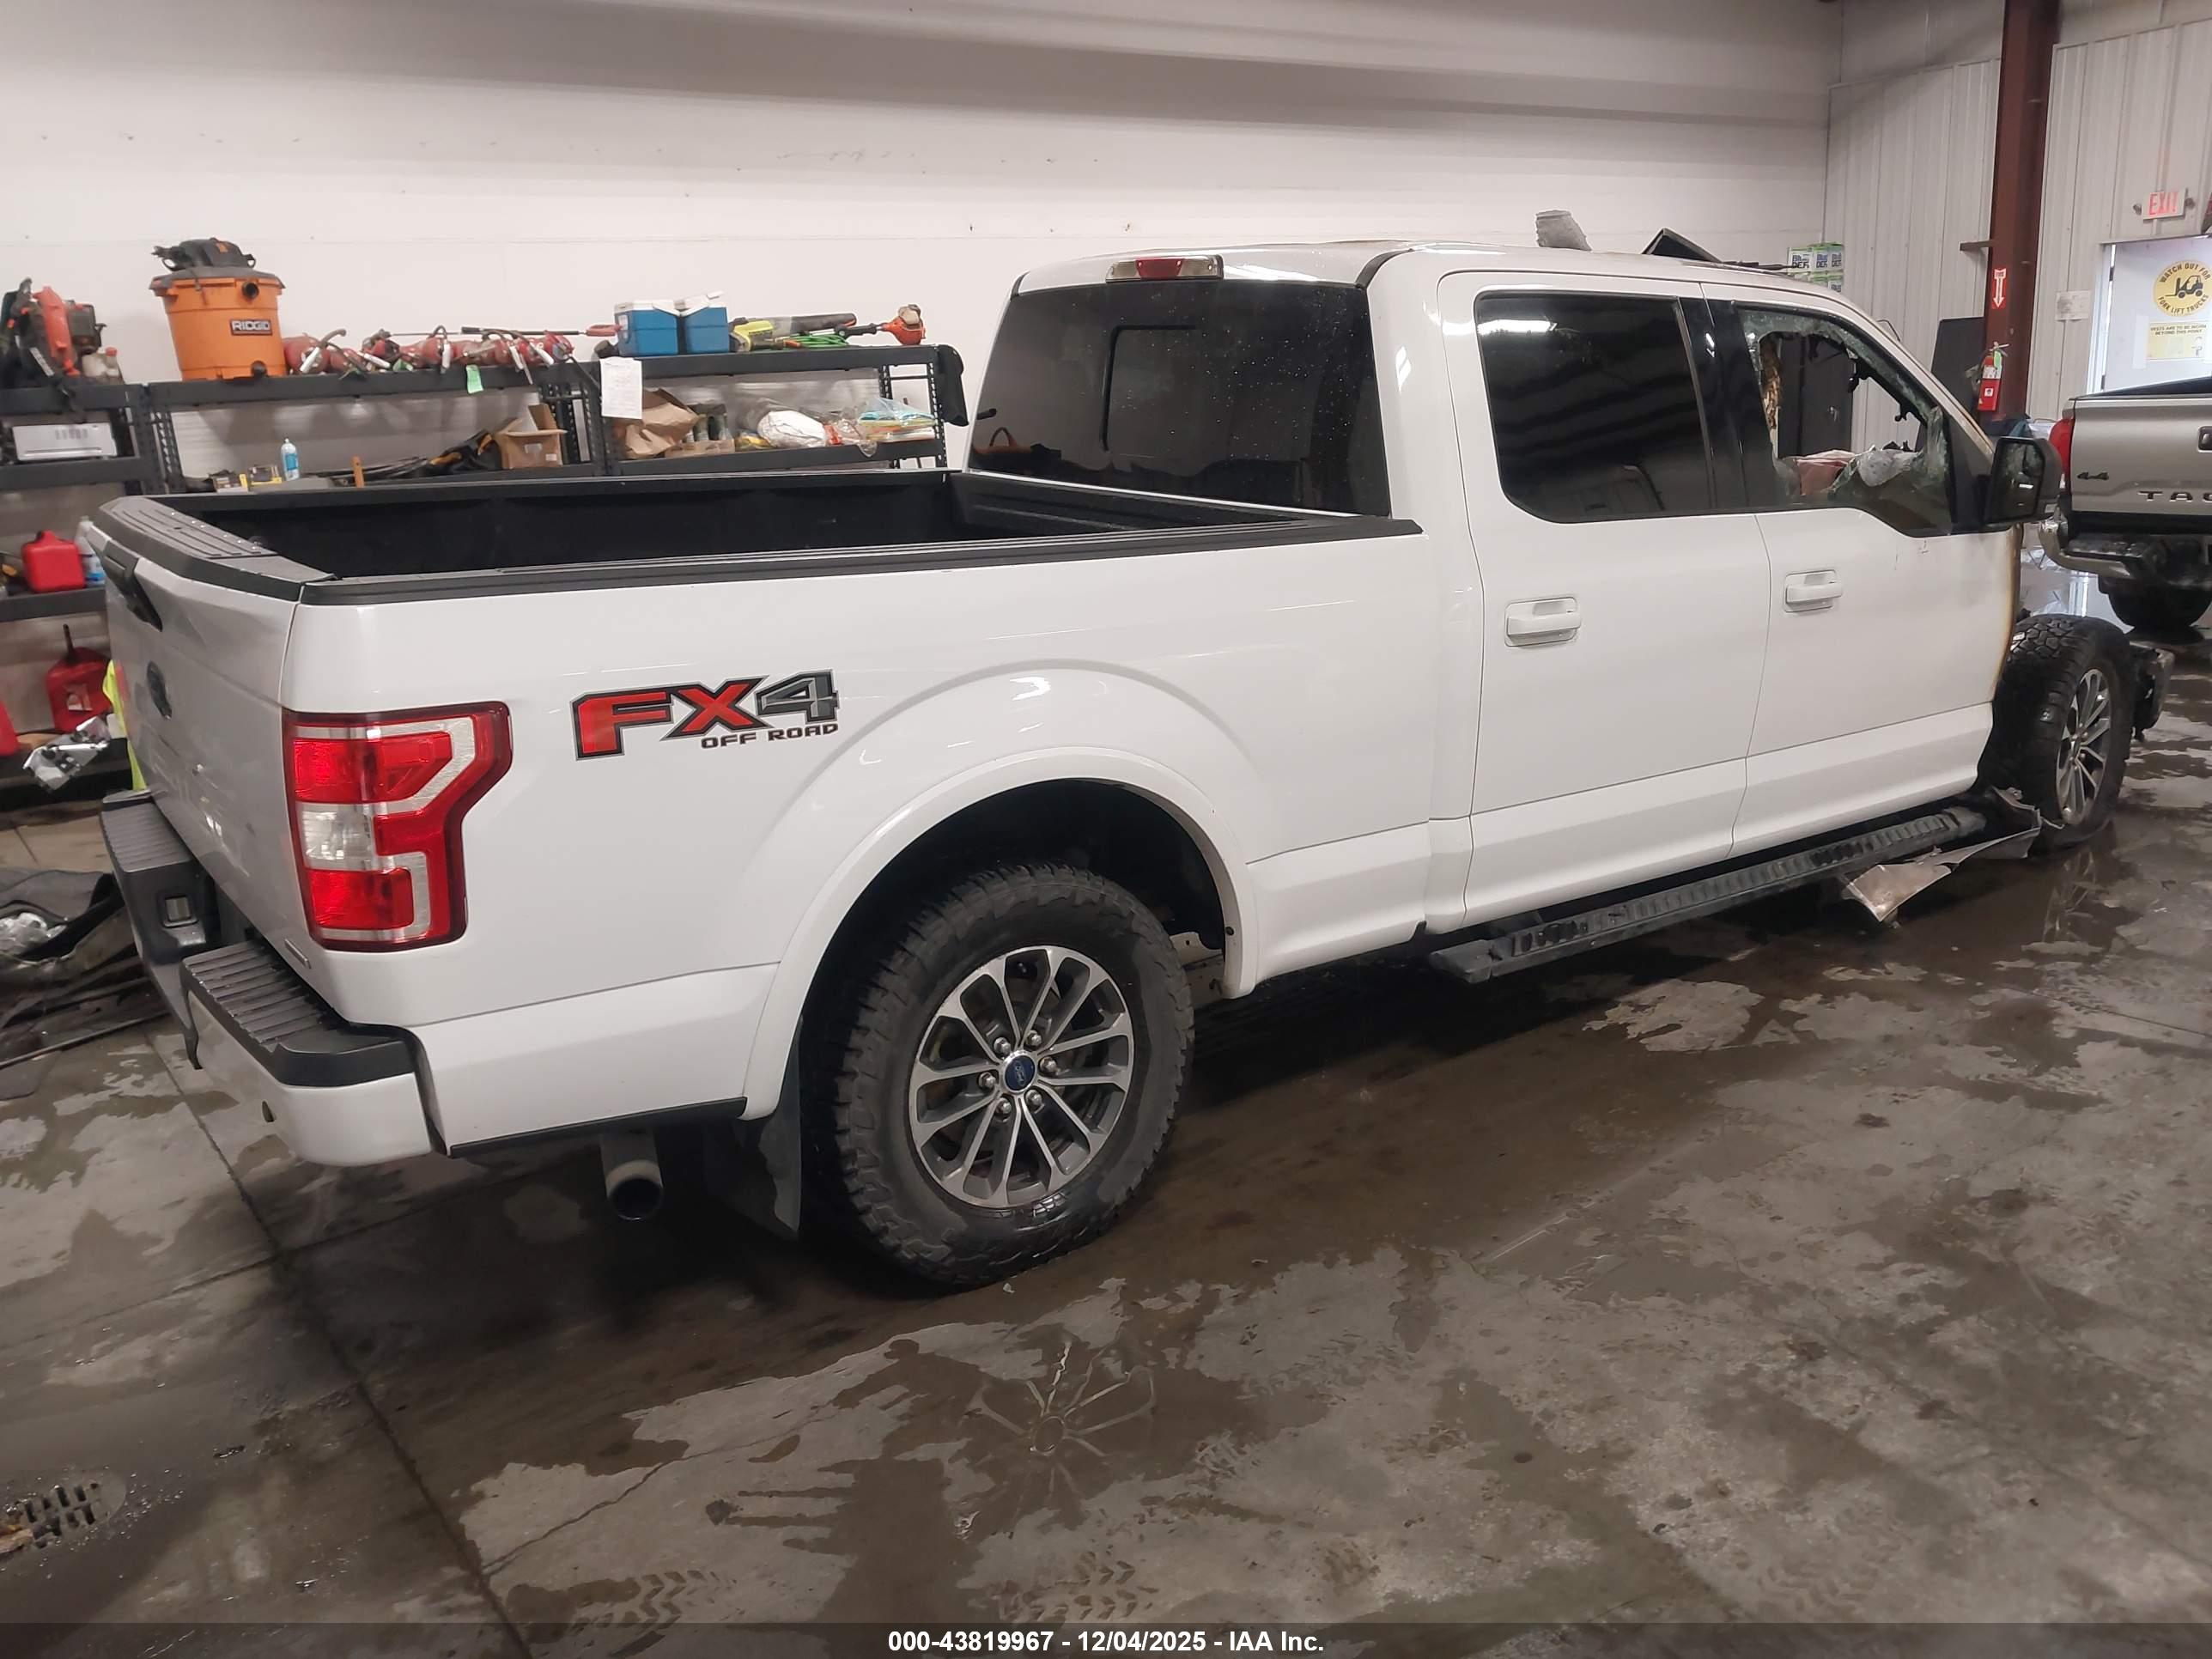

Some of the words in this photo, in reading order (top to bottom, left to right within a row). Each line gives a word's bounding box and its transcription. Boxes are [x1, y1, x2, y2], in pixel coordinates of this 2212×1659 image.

[2149, 192, 2179, 215] EXIT
[2159, 264, 2182, 283] WATCH
[2199, 267, 2211, 280] FOR
[2158, 296, 2170, 310] FORK
[2187, 295, 2209, 312] TRUCKS
[232, 320, 270, 331] RIDGID
[569, 669, 839, 761] FX4
[702, 732, 757, 749] OFF
[768, 723, 839, 741] ROAD
